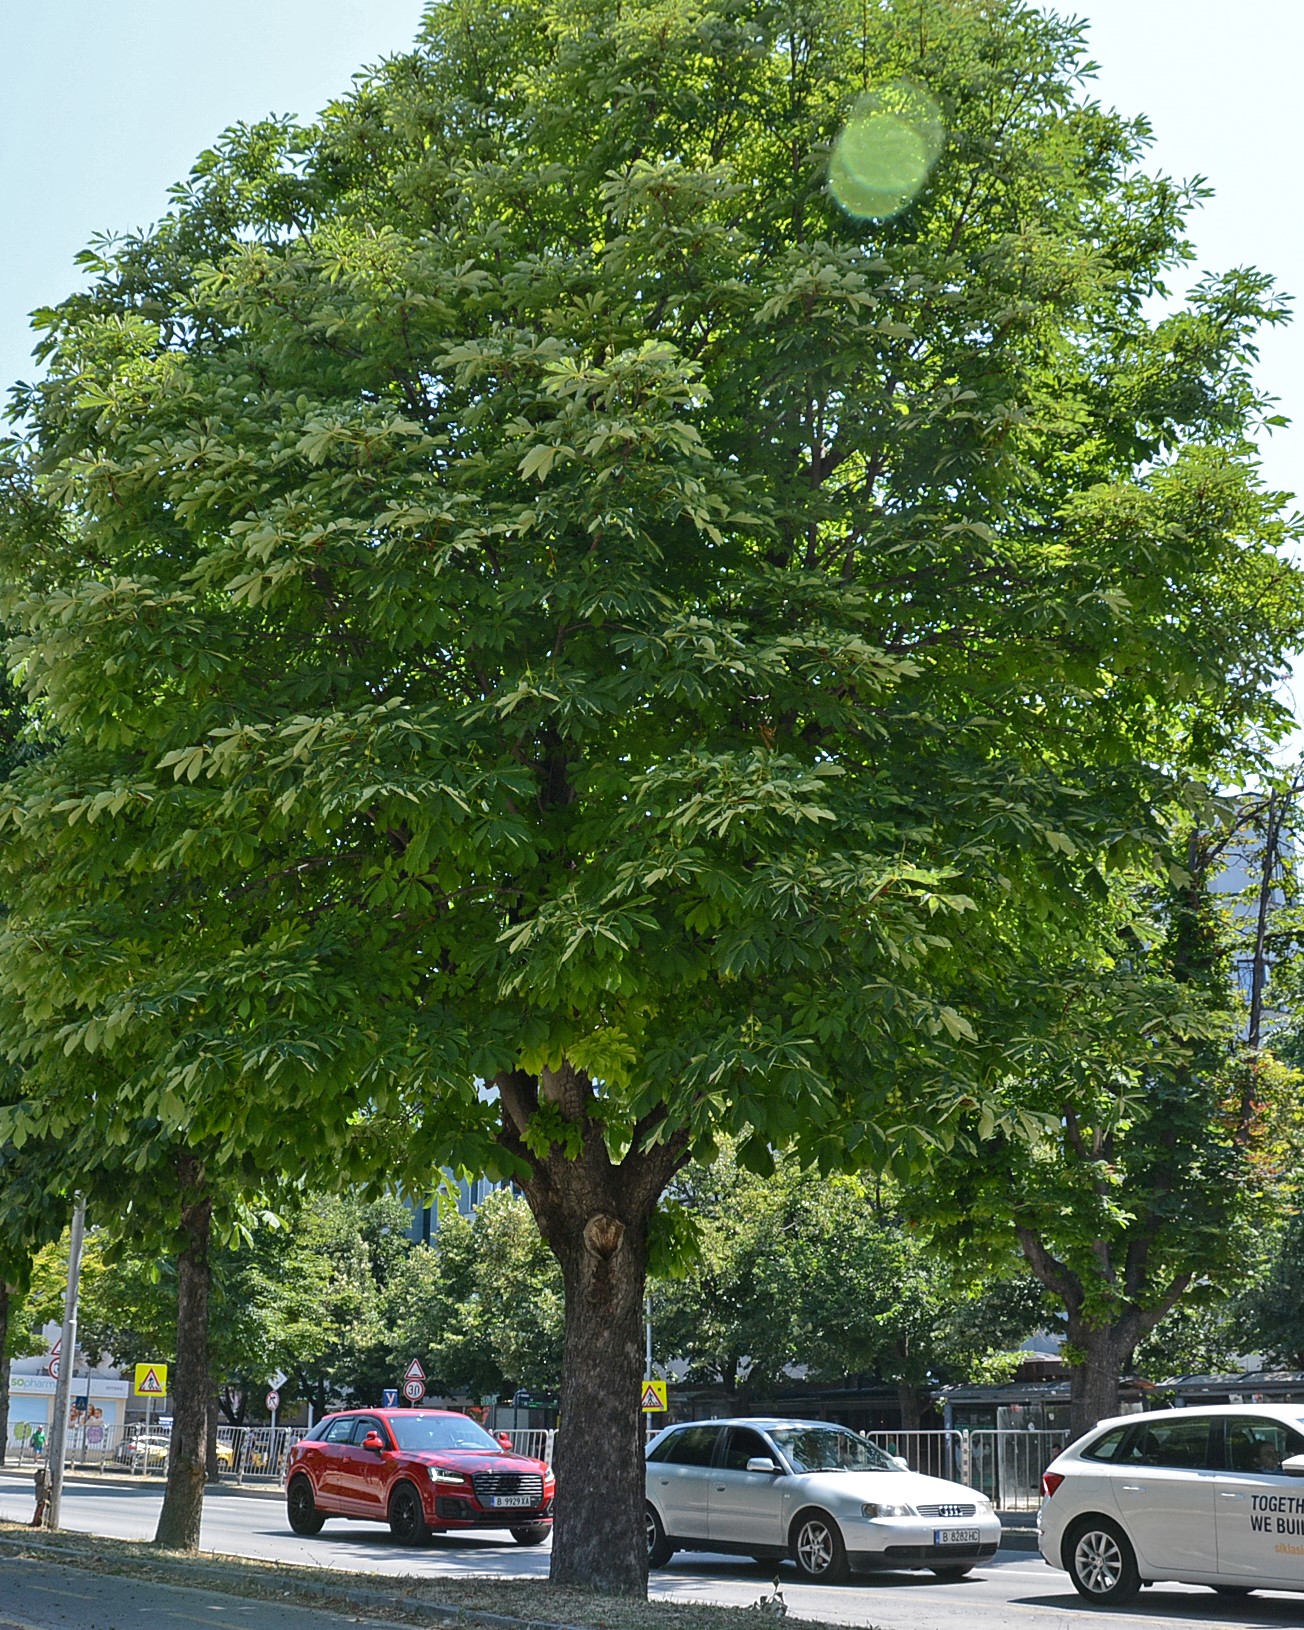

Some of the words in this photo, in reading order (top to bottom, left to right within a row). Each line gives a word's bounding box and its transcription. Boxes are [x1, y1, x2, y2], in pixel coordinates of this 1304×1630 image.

[408, 1385, 420, 1397] 30
[1251, 1494, 1304, 1514] TOGETH
[1250, 1515, 1272, 1533] WE
